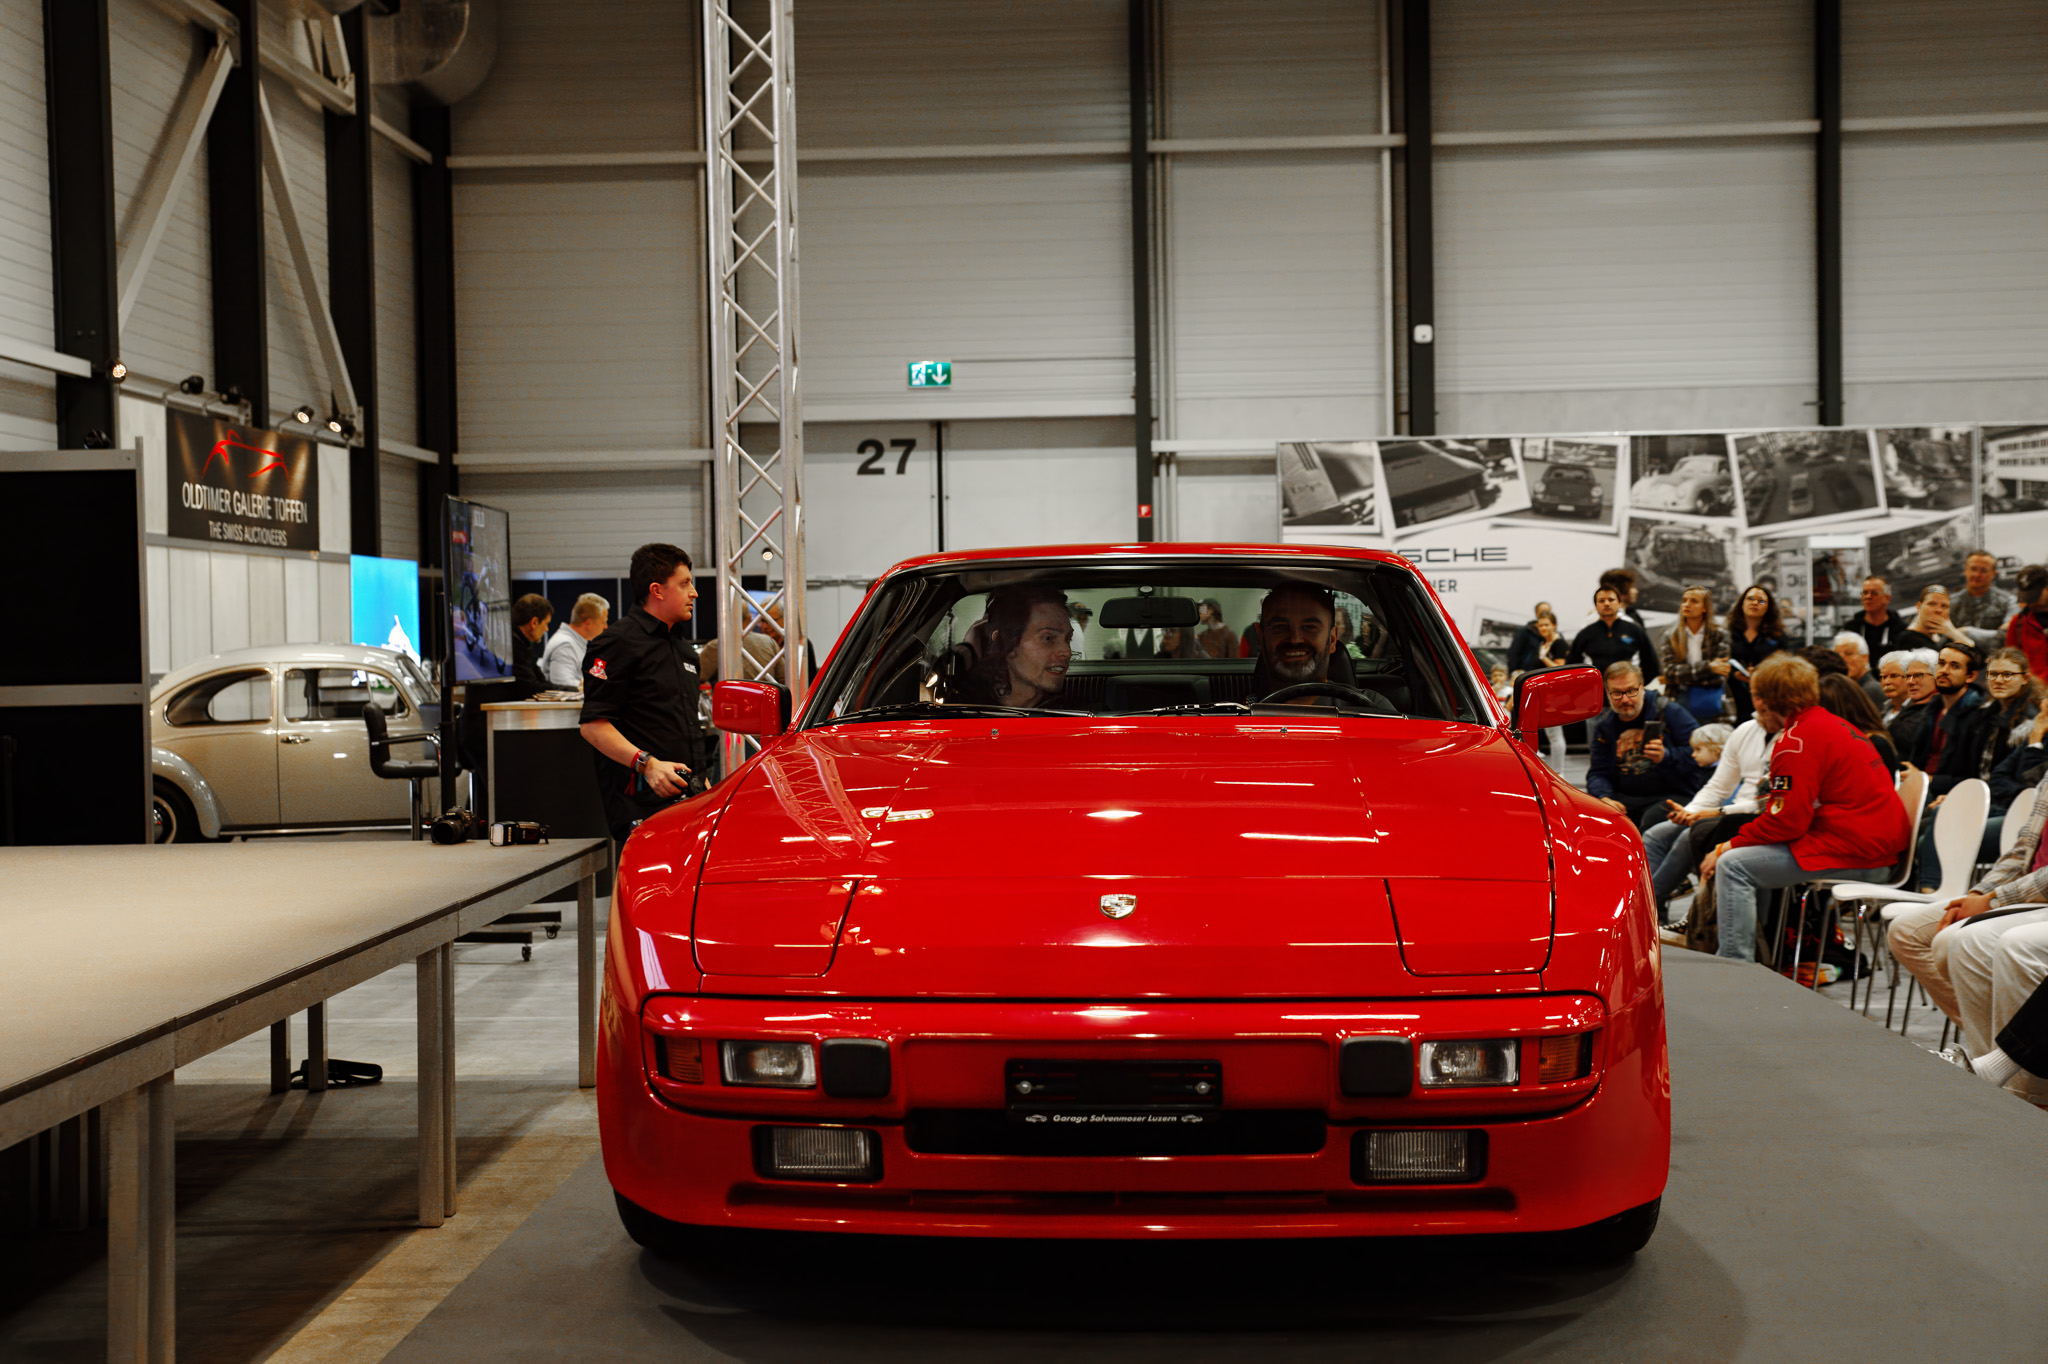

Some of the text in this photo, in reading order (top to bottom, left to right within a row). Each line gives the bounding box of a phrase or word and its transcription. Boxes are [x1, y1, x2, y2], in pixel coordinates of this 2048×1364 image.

[856, 438, 917, 475] 27
[182, 482, 308, 523] OLDTIMER GALERIE TOFFEN
[209, 521, 287, 546] THE SWISS AUCTIONEERS
[1396, 547, 1507, 563] SCHE
[1053, 1114, 1088, 1123] Garage
[1147, 1114, 1177, 1122] Luzern
